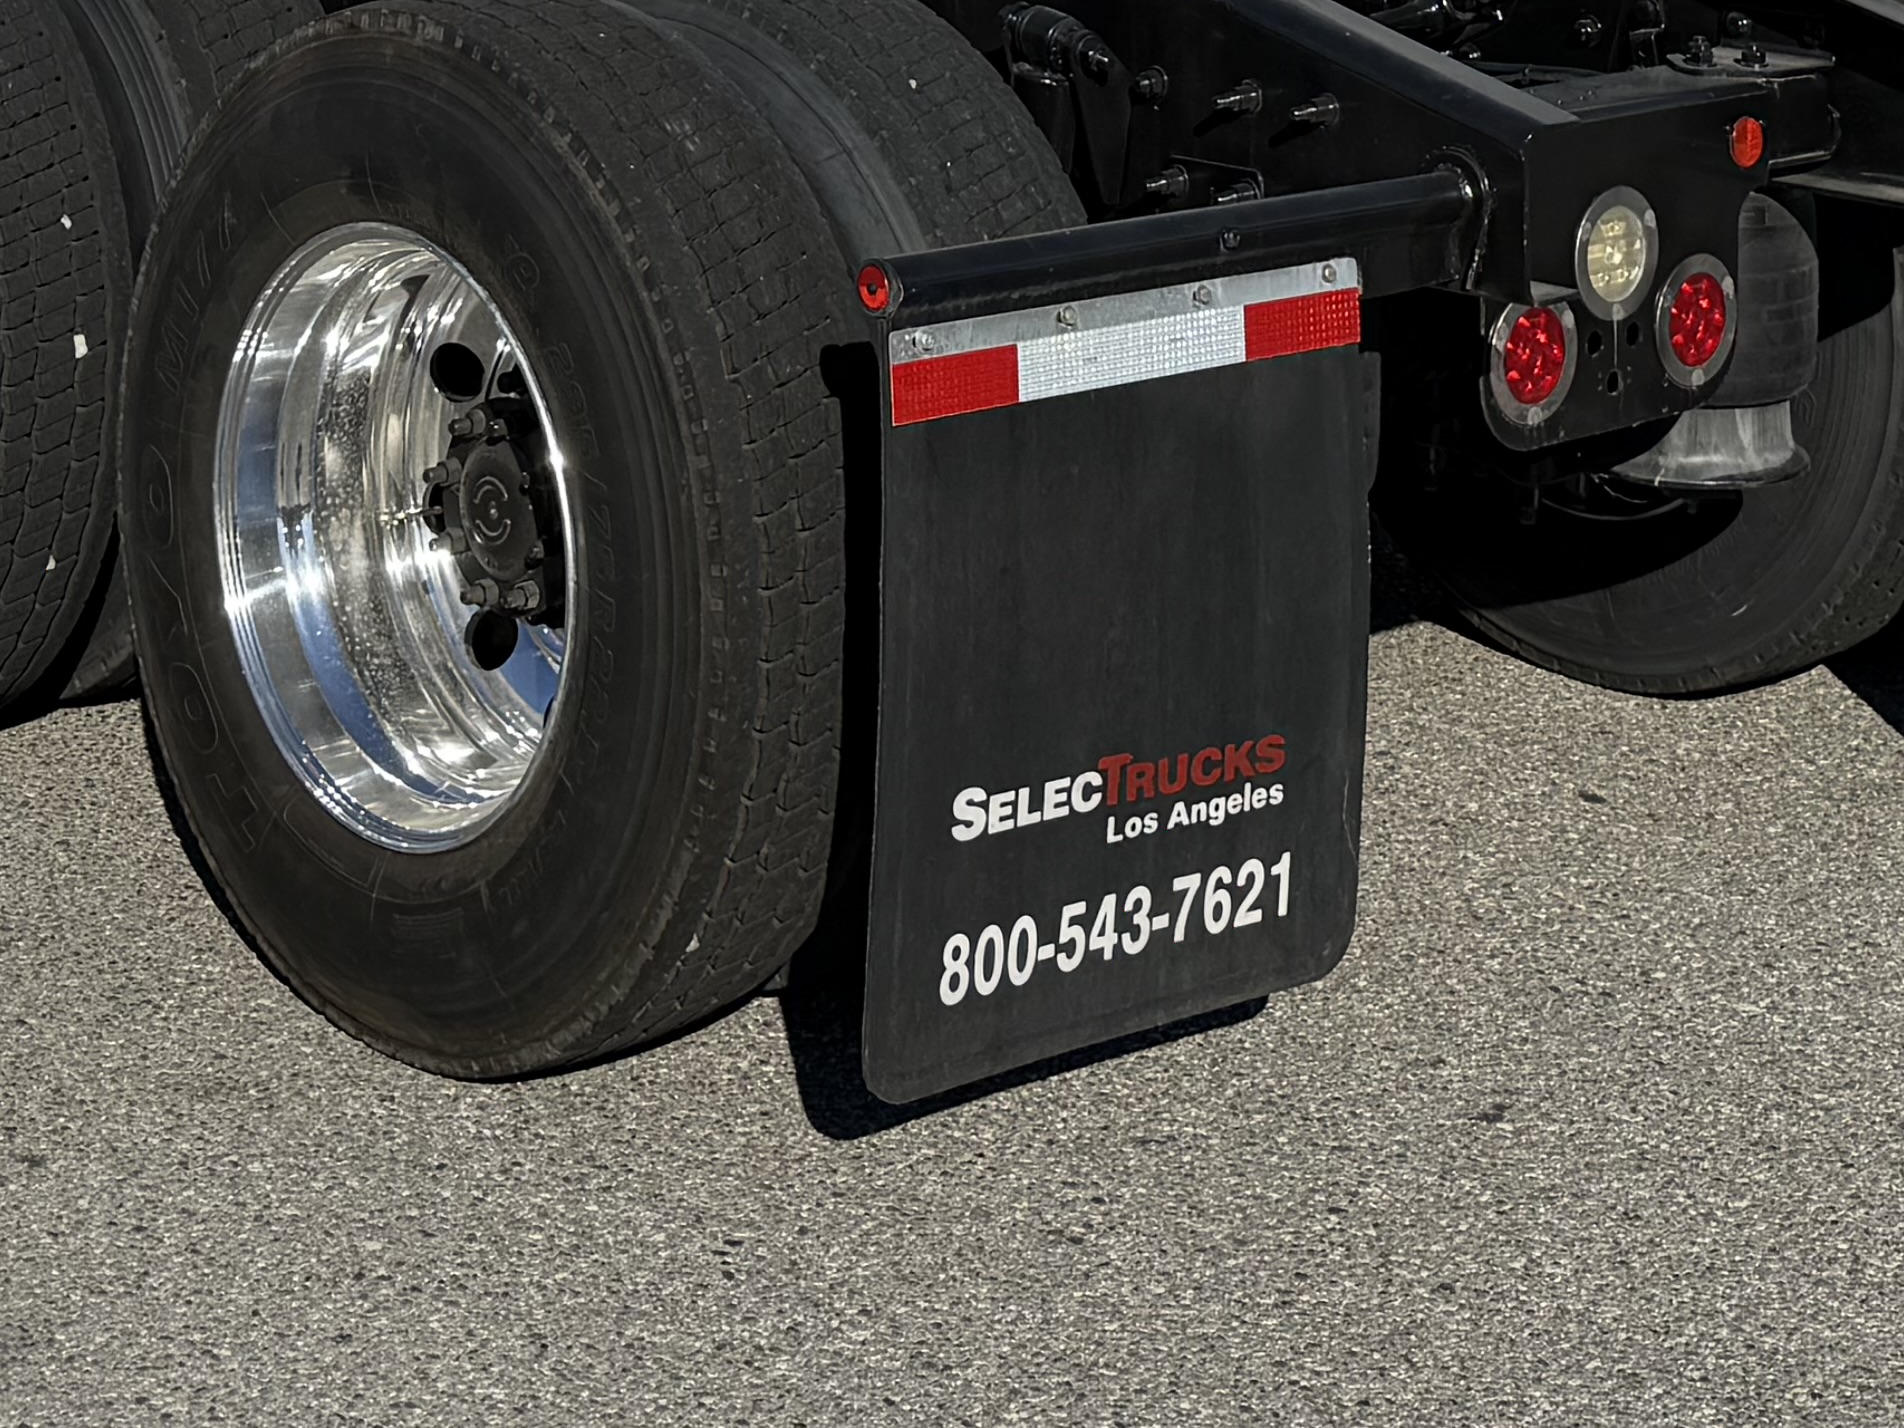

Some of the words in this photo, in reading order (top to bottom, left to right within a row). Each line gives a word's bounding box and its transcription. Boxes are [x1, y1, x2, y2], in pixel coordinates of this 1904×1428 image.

[142, 441, 260, 855] TOYO
[951, 734, 1286, 842] SELECTRUCKS
[1106, 808, 1159, 844] Los
[1167, 780, 1285, 829] Angeles
[939, 851, 1292, 1006] 800-543-7621
